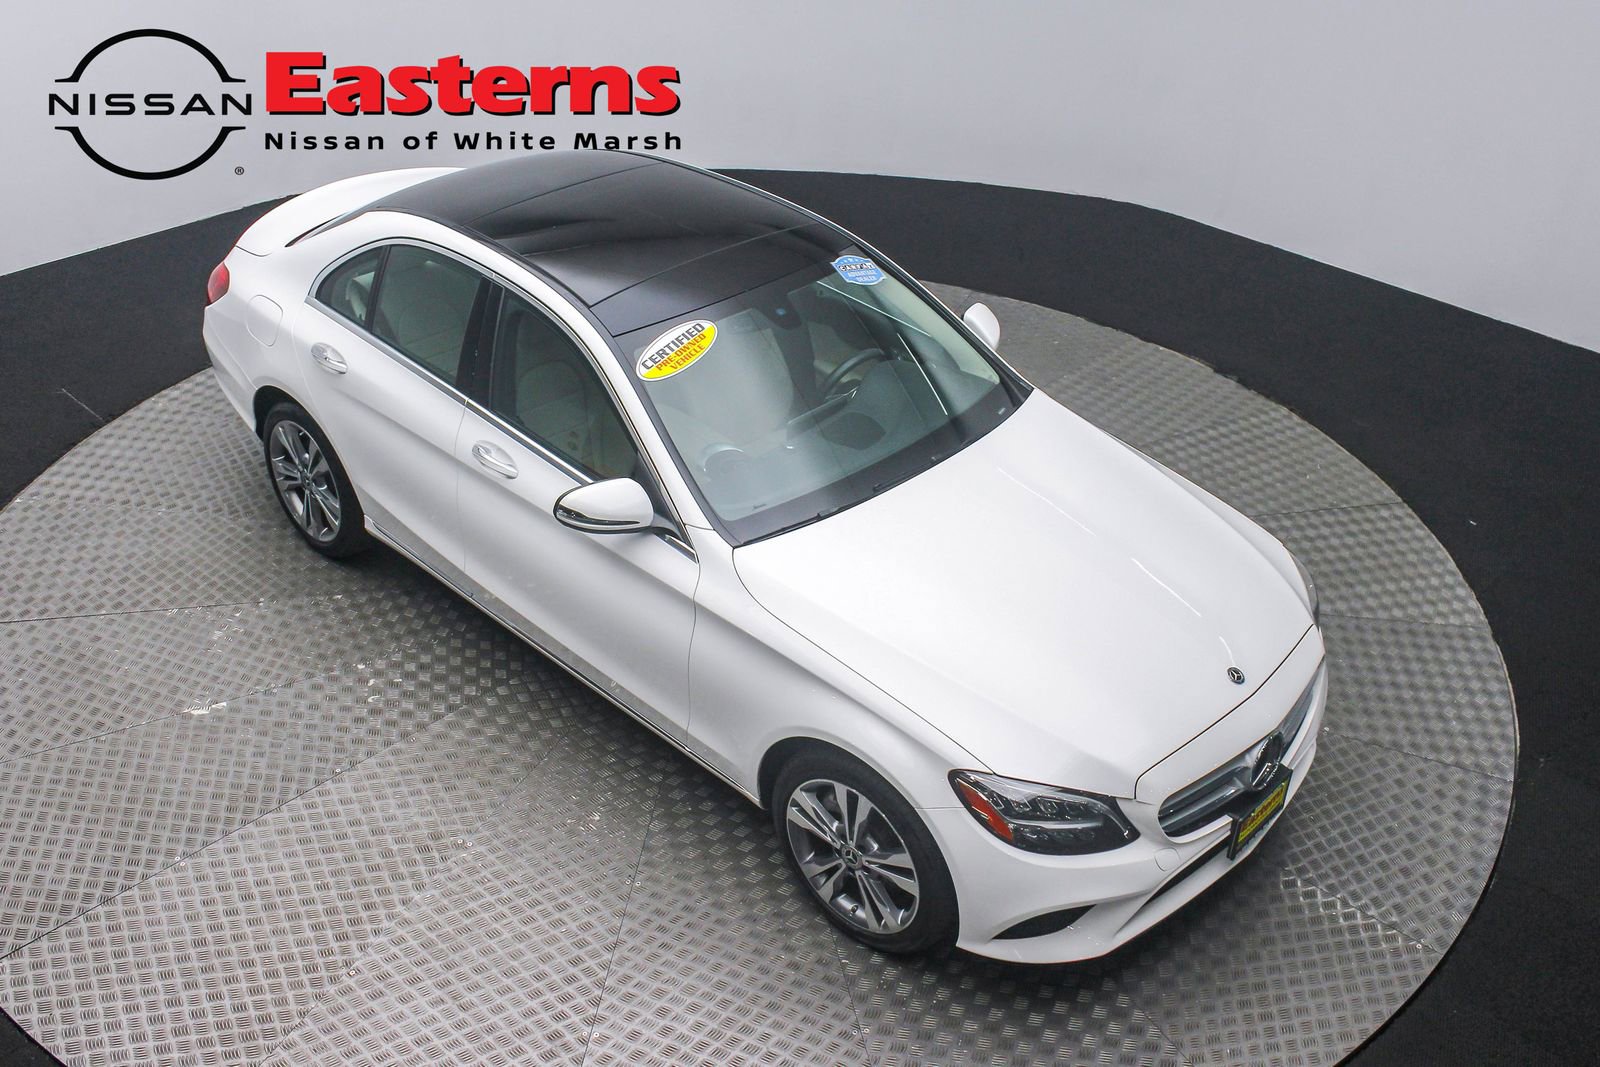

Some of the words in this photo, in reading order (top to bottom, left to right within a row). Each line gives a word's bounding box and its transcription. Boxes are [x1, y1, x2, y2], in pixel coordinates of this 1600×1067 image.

[641, 323, 706, 370] CERTIFIED
[655, 333, 707, 371] PRE-OWNED
[669, 343, 706, 370] VEHICLE
